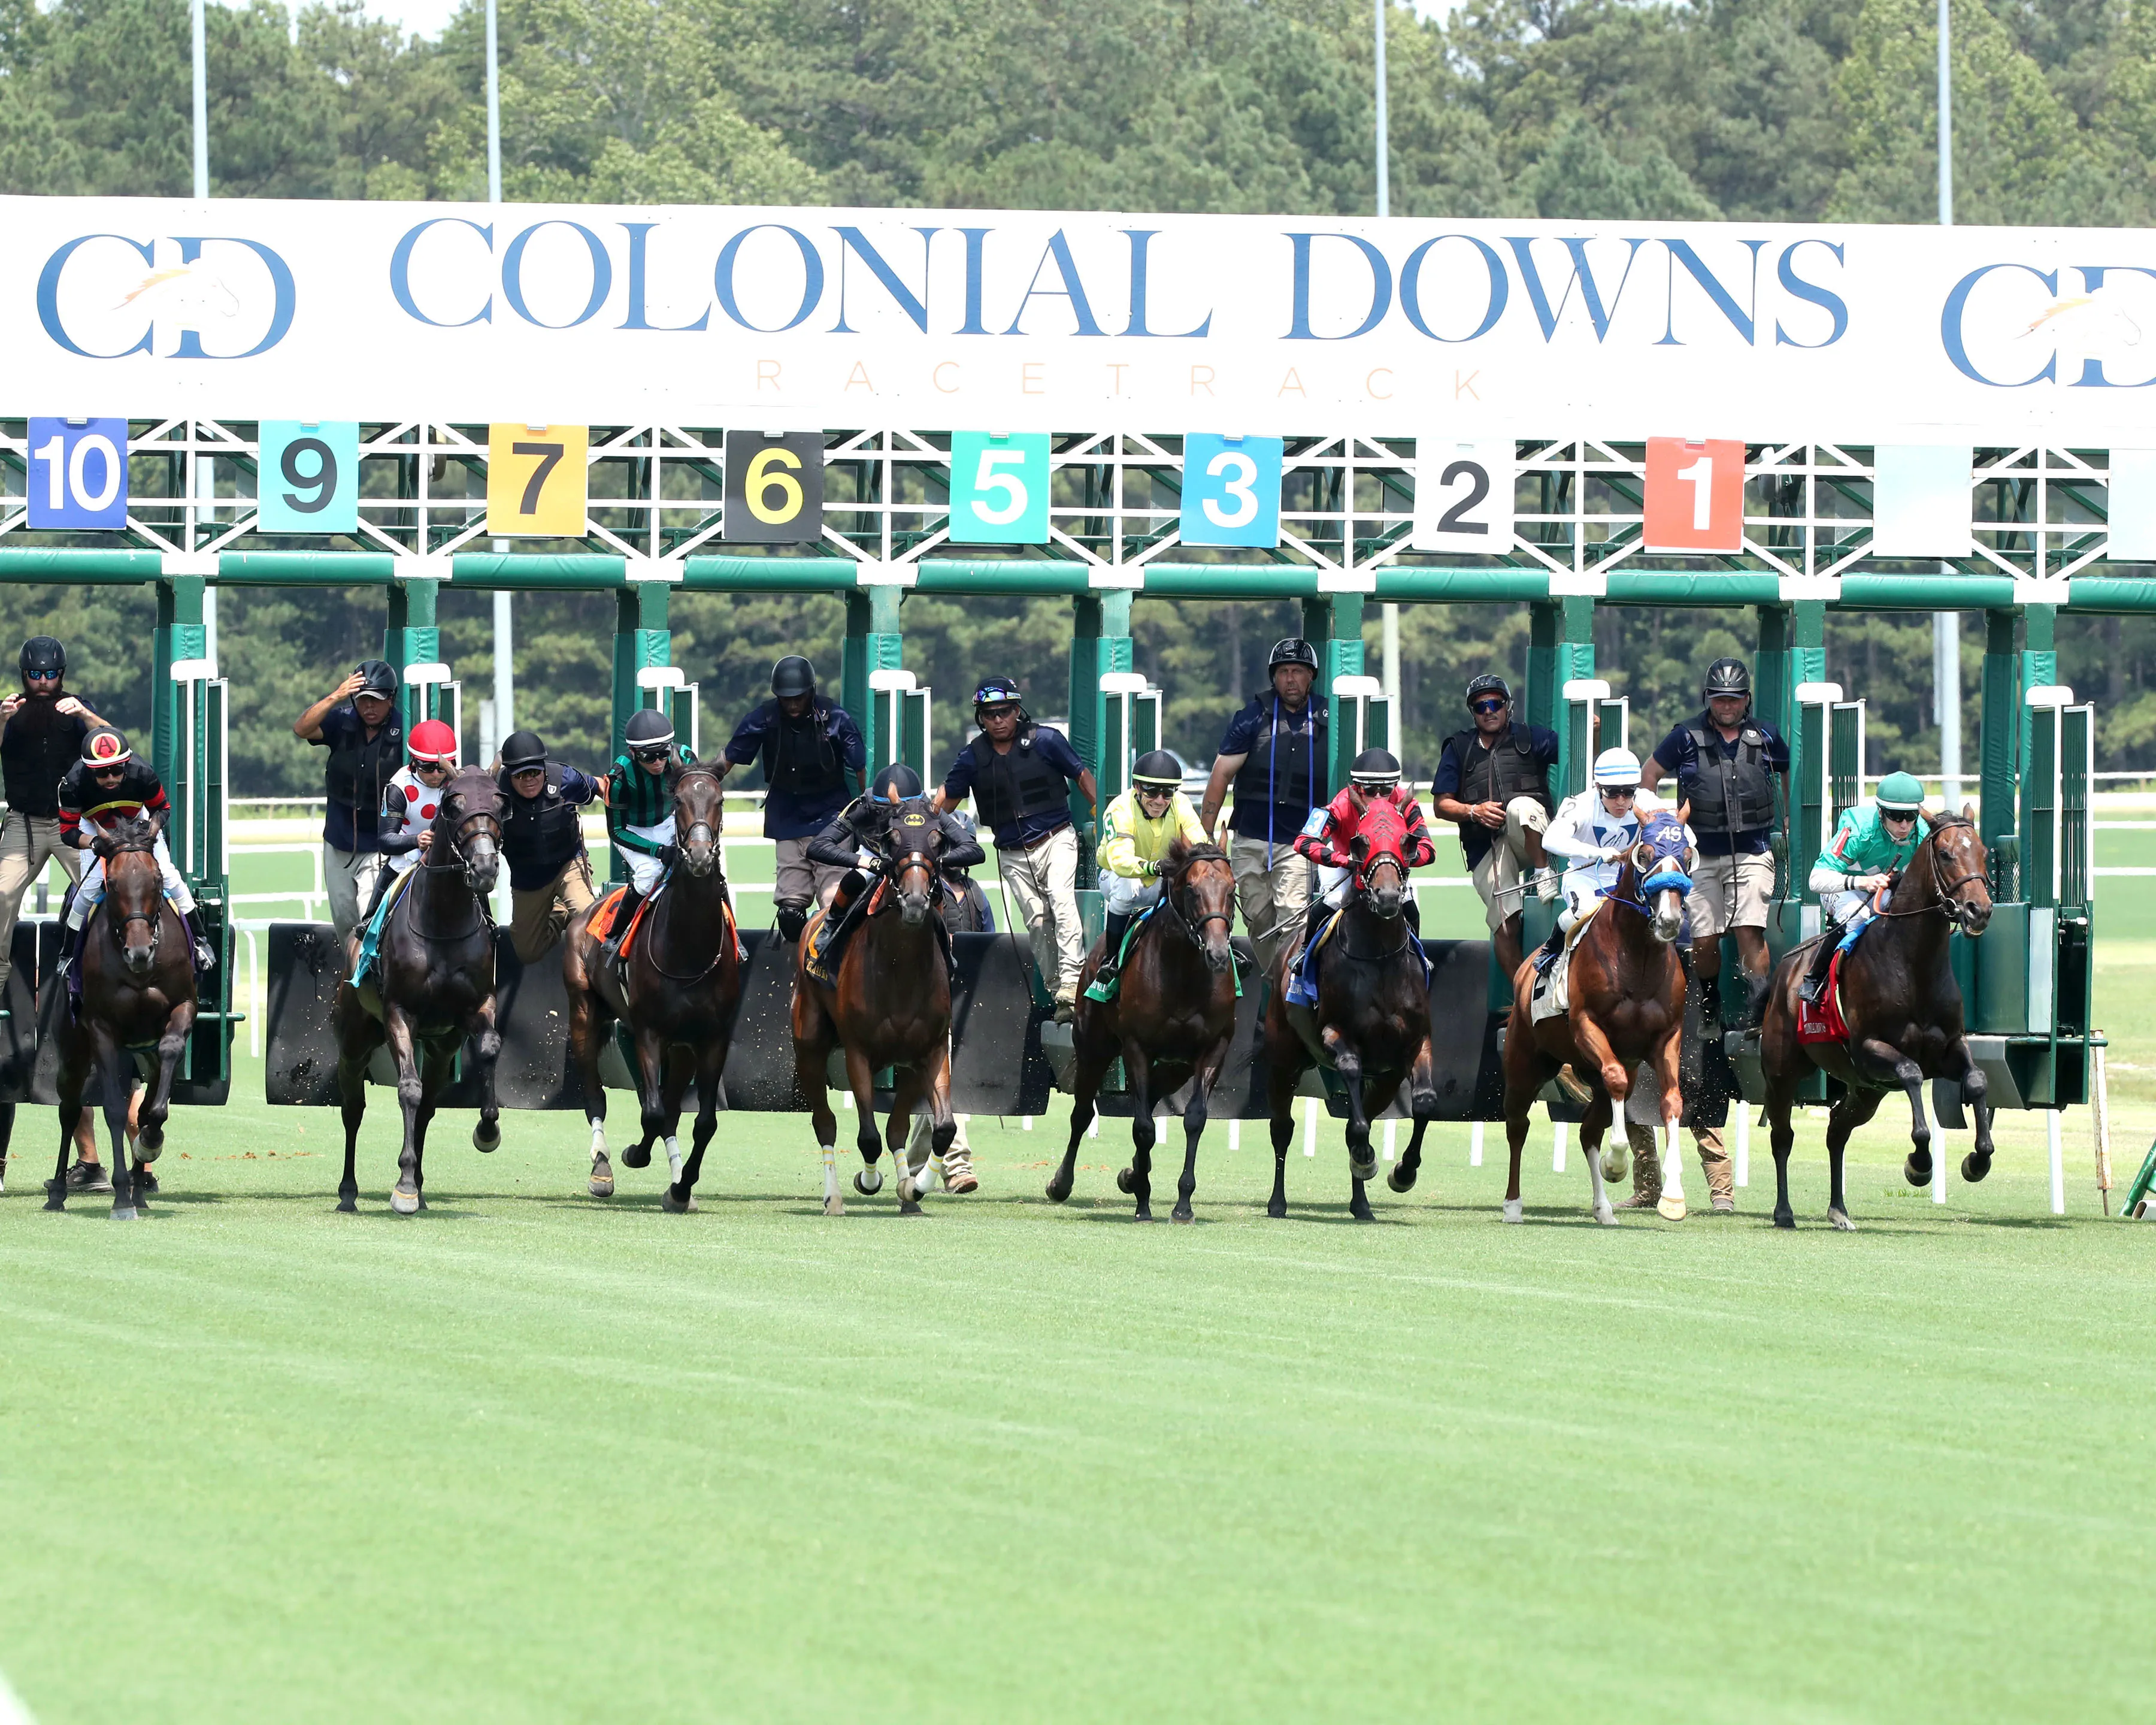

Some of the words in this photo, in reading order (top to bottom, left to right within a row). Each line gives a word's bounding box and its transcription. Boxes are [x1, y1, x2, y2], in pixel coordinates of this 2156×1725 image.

[37, 234, 296, 359] CD
[389, 219, 1213, 337] COLONIAL
[1279, 234, 1848, 348] DOWNS
[757, 359, 1481, 401] RACETRACK
[34, 434, 121, 512] 10
[281, 438, 337, 513] 9
[512, 443, 564, 515] 7
[744, 448, 804, 524] 6
[971, 450, 1028, 525] 5
[1202, 452, 1259, 528] 3
[1437, 461, 1489, 535] 2
[1677, 456, 1712, 530] 1
[97, 736, 116, 755] A
[1104, 813, 1115, 840] 5
[1306, 811, 1325, 834] 3
[1655, 826, 1682, 842] AS
